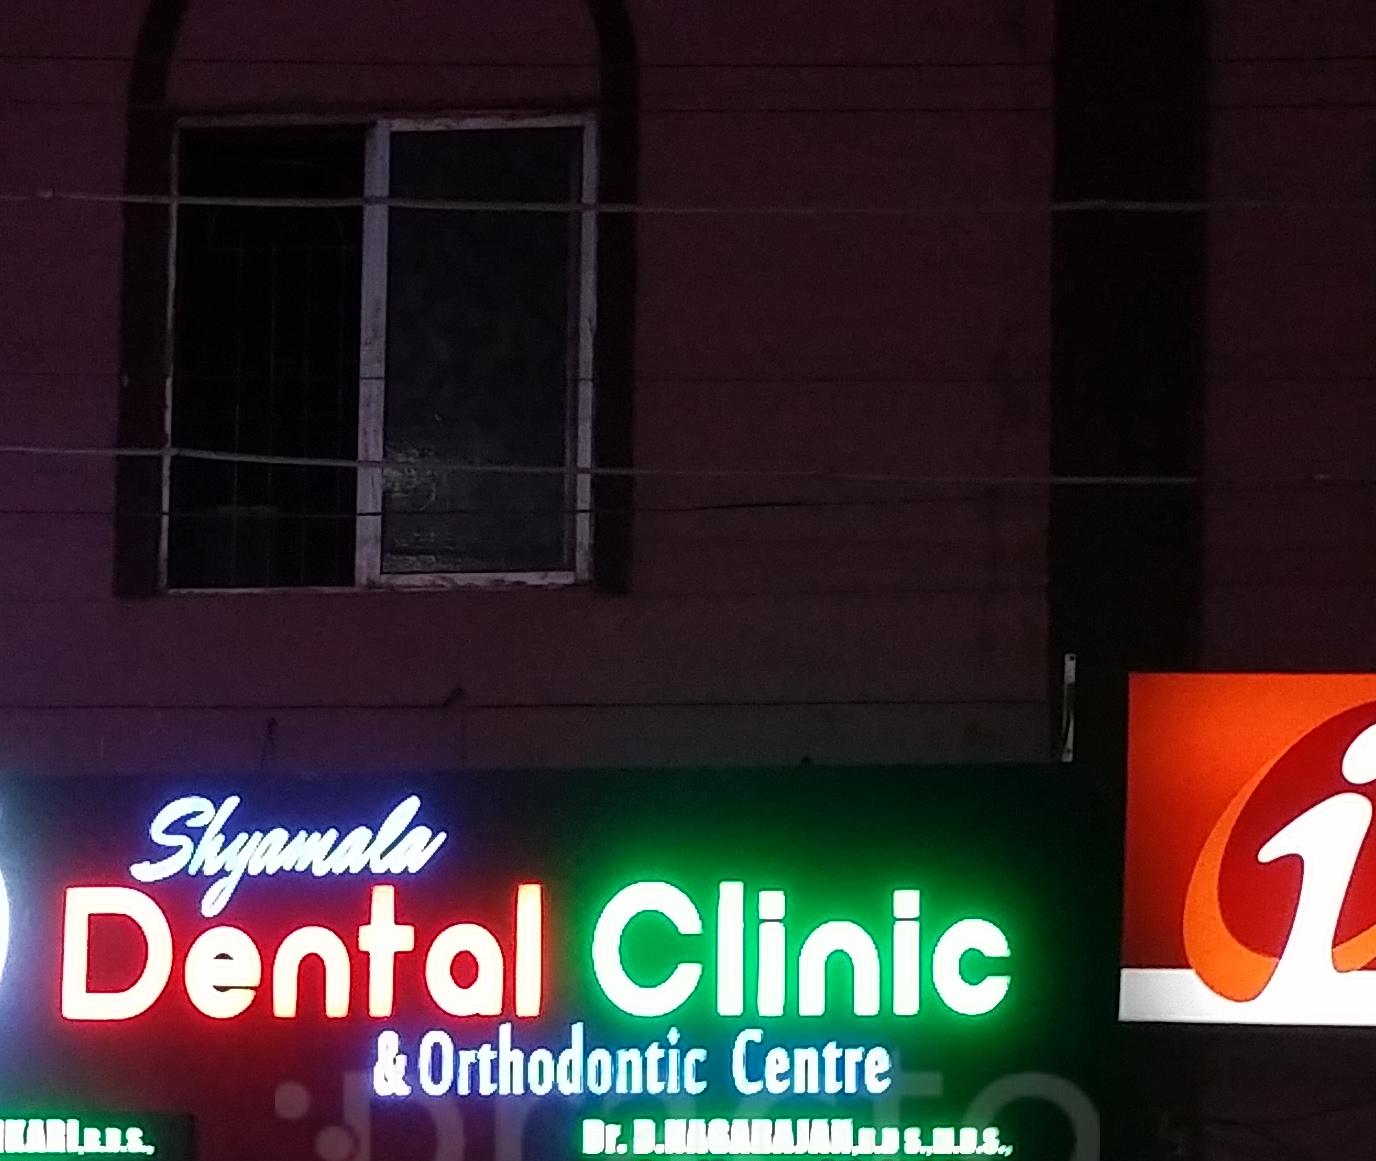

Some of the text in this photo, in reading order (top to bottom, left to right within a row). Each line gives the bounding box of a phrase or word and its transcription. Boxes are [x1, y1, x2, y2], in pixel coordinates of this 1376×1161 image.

[131, 795, 449, 916] Shyamala
[62, 879, 1012, 1021] Dental Clinic
[418, 1021, 707, 1099] Orthodontic
[732, 1029, 892, 1096] Centre
[581, 1118, 628, 1155] Dr.
